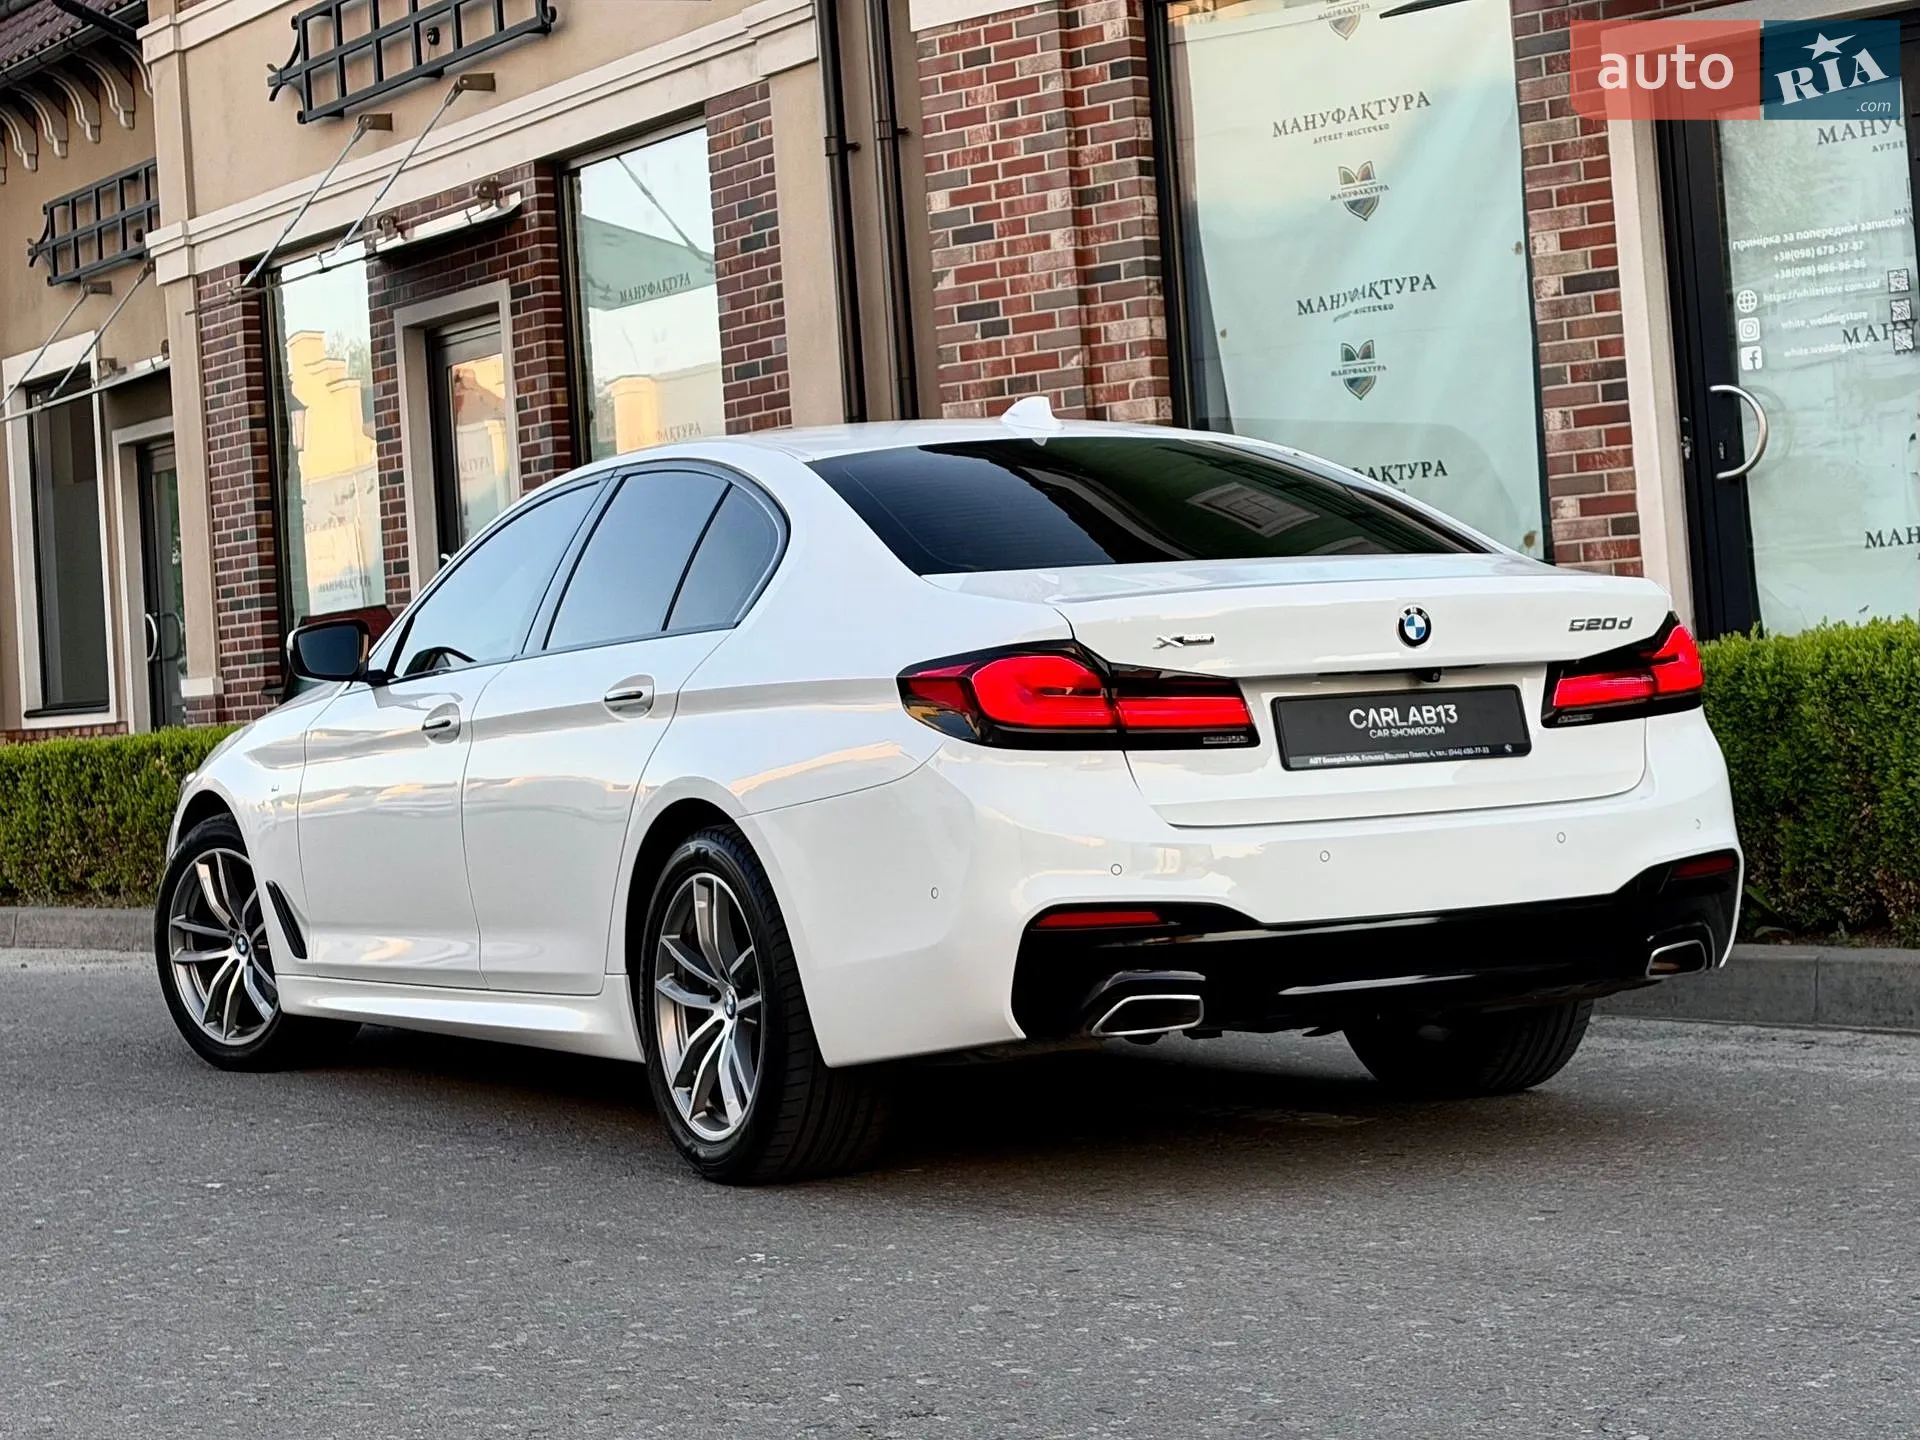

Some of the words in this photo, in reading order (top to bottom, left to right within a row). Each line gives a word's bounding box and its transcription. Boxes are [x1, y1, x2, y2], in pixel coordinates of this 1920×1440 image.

[1272, 91, 1431, 138] МАНУФАКТУРА
[1783, 232, 1795, 243] за
[1349, 703, 1459, 729] CARLAB13
[1369, 729, 1390, 739] CAR
[1390, 725, 1445, 738] SHOWROOM
